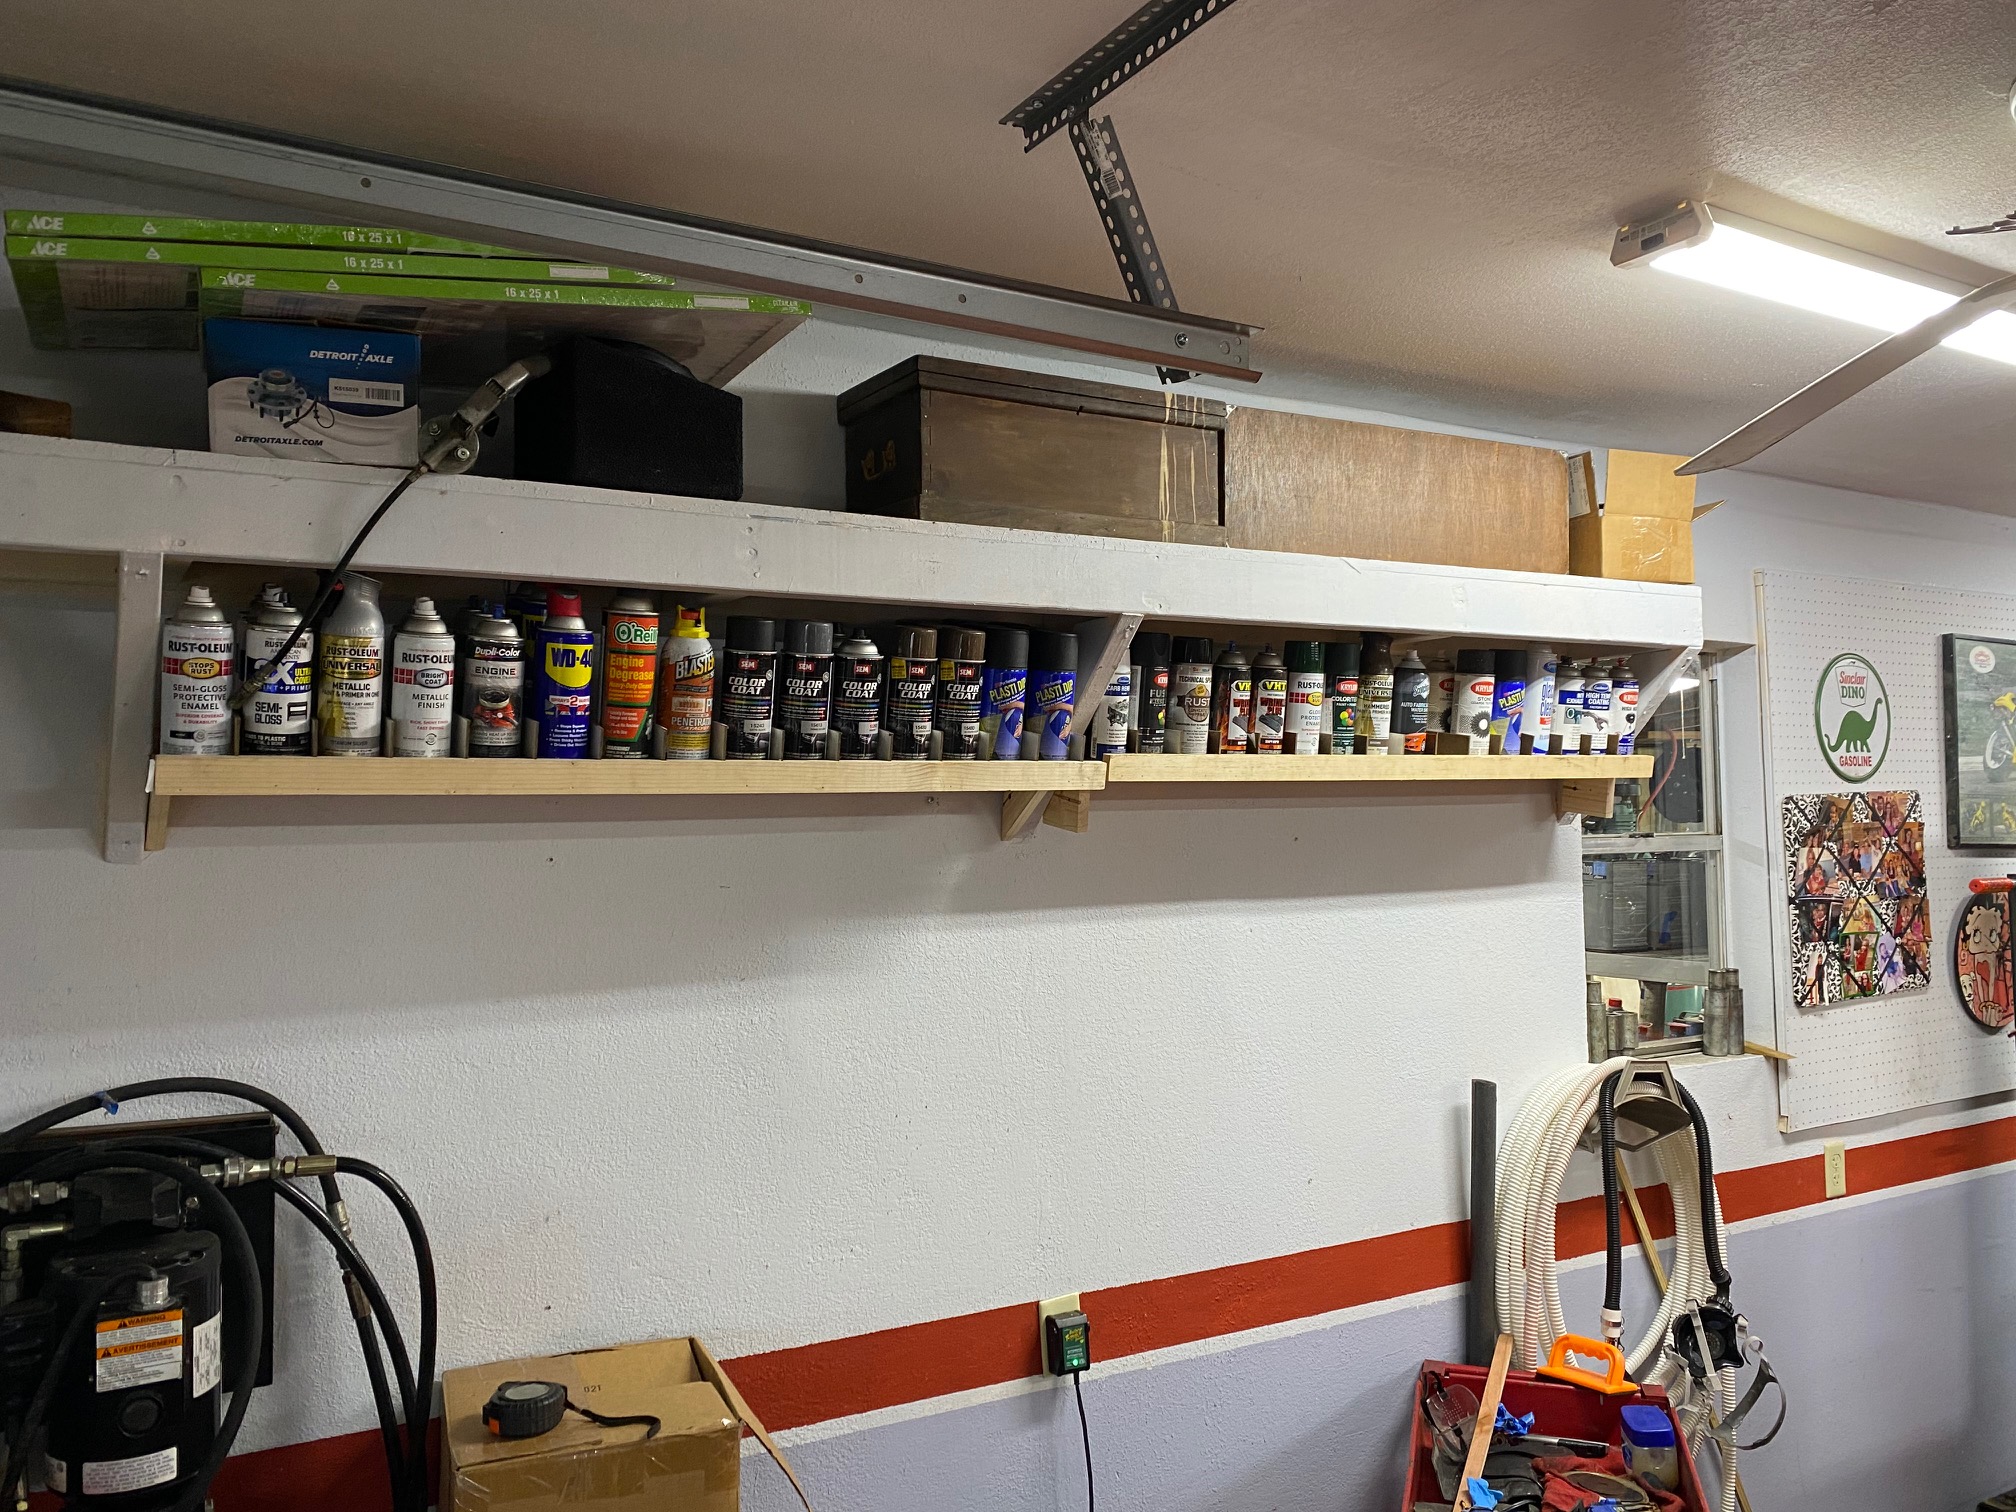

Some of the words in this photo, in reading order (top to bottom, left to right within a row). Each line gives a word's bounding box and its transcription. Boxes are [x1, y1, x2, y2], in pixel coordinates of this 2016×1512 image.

[27, 215, 64, 232] ACE
[342, 231, 355, 243] 16
[369, 232, 383, 244] 25
[396, 233, 402, 245] 1
[30, 240, 67, 257] ACE
[344, 257, 356, 268] 16
[370, 258, 384, 269] 25
[398, 258, 403, 270] 1
[221, 272, 256, 287] ACE
[505, 286, 516, 297] 16
[527, 287, 541, 298] 25
[554, 288, 559, 298] 1
[309, 350, 359, 362] DETROIT
[364, 354, 394, 364] AXLE
[235, 436, 323, 447] DETROITAXLE.COM
[326, 646, 379, 657] RUST-OLEUM
[474, 646, 521, 659] Dupli-Color
[321, 659, 381, 672] UNIVERSAL
[610, 654, 644, 669] Engine
[741, 660, 755, 669] SEM
[798, 663, 812, 671] SEM
[475, 666, 516, 676] ENGINE
[856, 665, 869, 673] SEM
[911, 666, 924, 675] SEM
[960, 668, 972, 676] SEM
[728, 676, 767, 687] COLOR
[786, 678, 823, 689] COLOR
[1839, 671, 1866, 685] Sinclair
[173, 684, 227, 692] SEMI-GLOSS
[332, 682, 371, 691] METALLIC
[731, 685, 765, 695] COAT
[789, 686, 822, 697] COAT
[842, 681, 878, 691] COLOR
[897, 682, 932, 692] COLOR
[946, 683, 980, 693] COLOR
[1265, 682, 1287, 690] VHT
[173, 693, 226, 701] PROTECTIVE
[845, 689, 877, 699] COAT
[901, 690, 930, 699] COAT
[949, 691, 978, 700] COAT
[989, 683, 1018, 702] PLASTI
[1035, 684, 1063, 703] PLASTI
[1841, 685, 1865, 699] DINO
[181, 702, 219, 710] ENAMEL
[569, 696, 578, 707] 2
[1184, 697, 1210, 707] RUST
[255, 702, 283, 713] SEMI-
[255, 713, 282, 725] GLOSS
[1839, 756, 1872, 767] GASOLINE
[1961, 950, 1968, 966] 9
[128, 1313, 166, 1326] WARNING
[113, 1337, 179, 1355] AVERTISSEMENT
